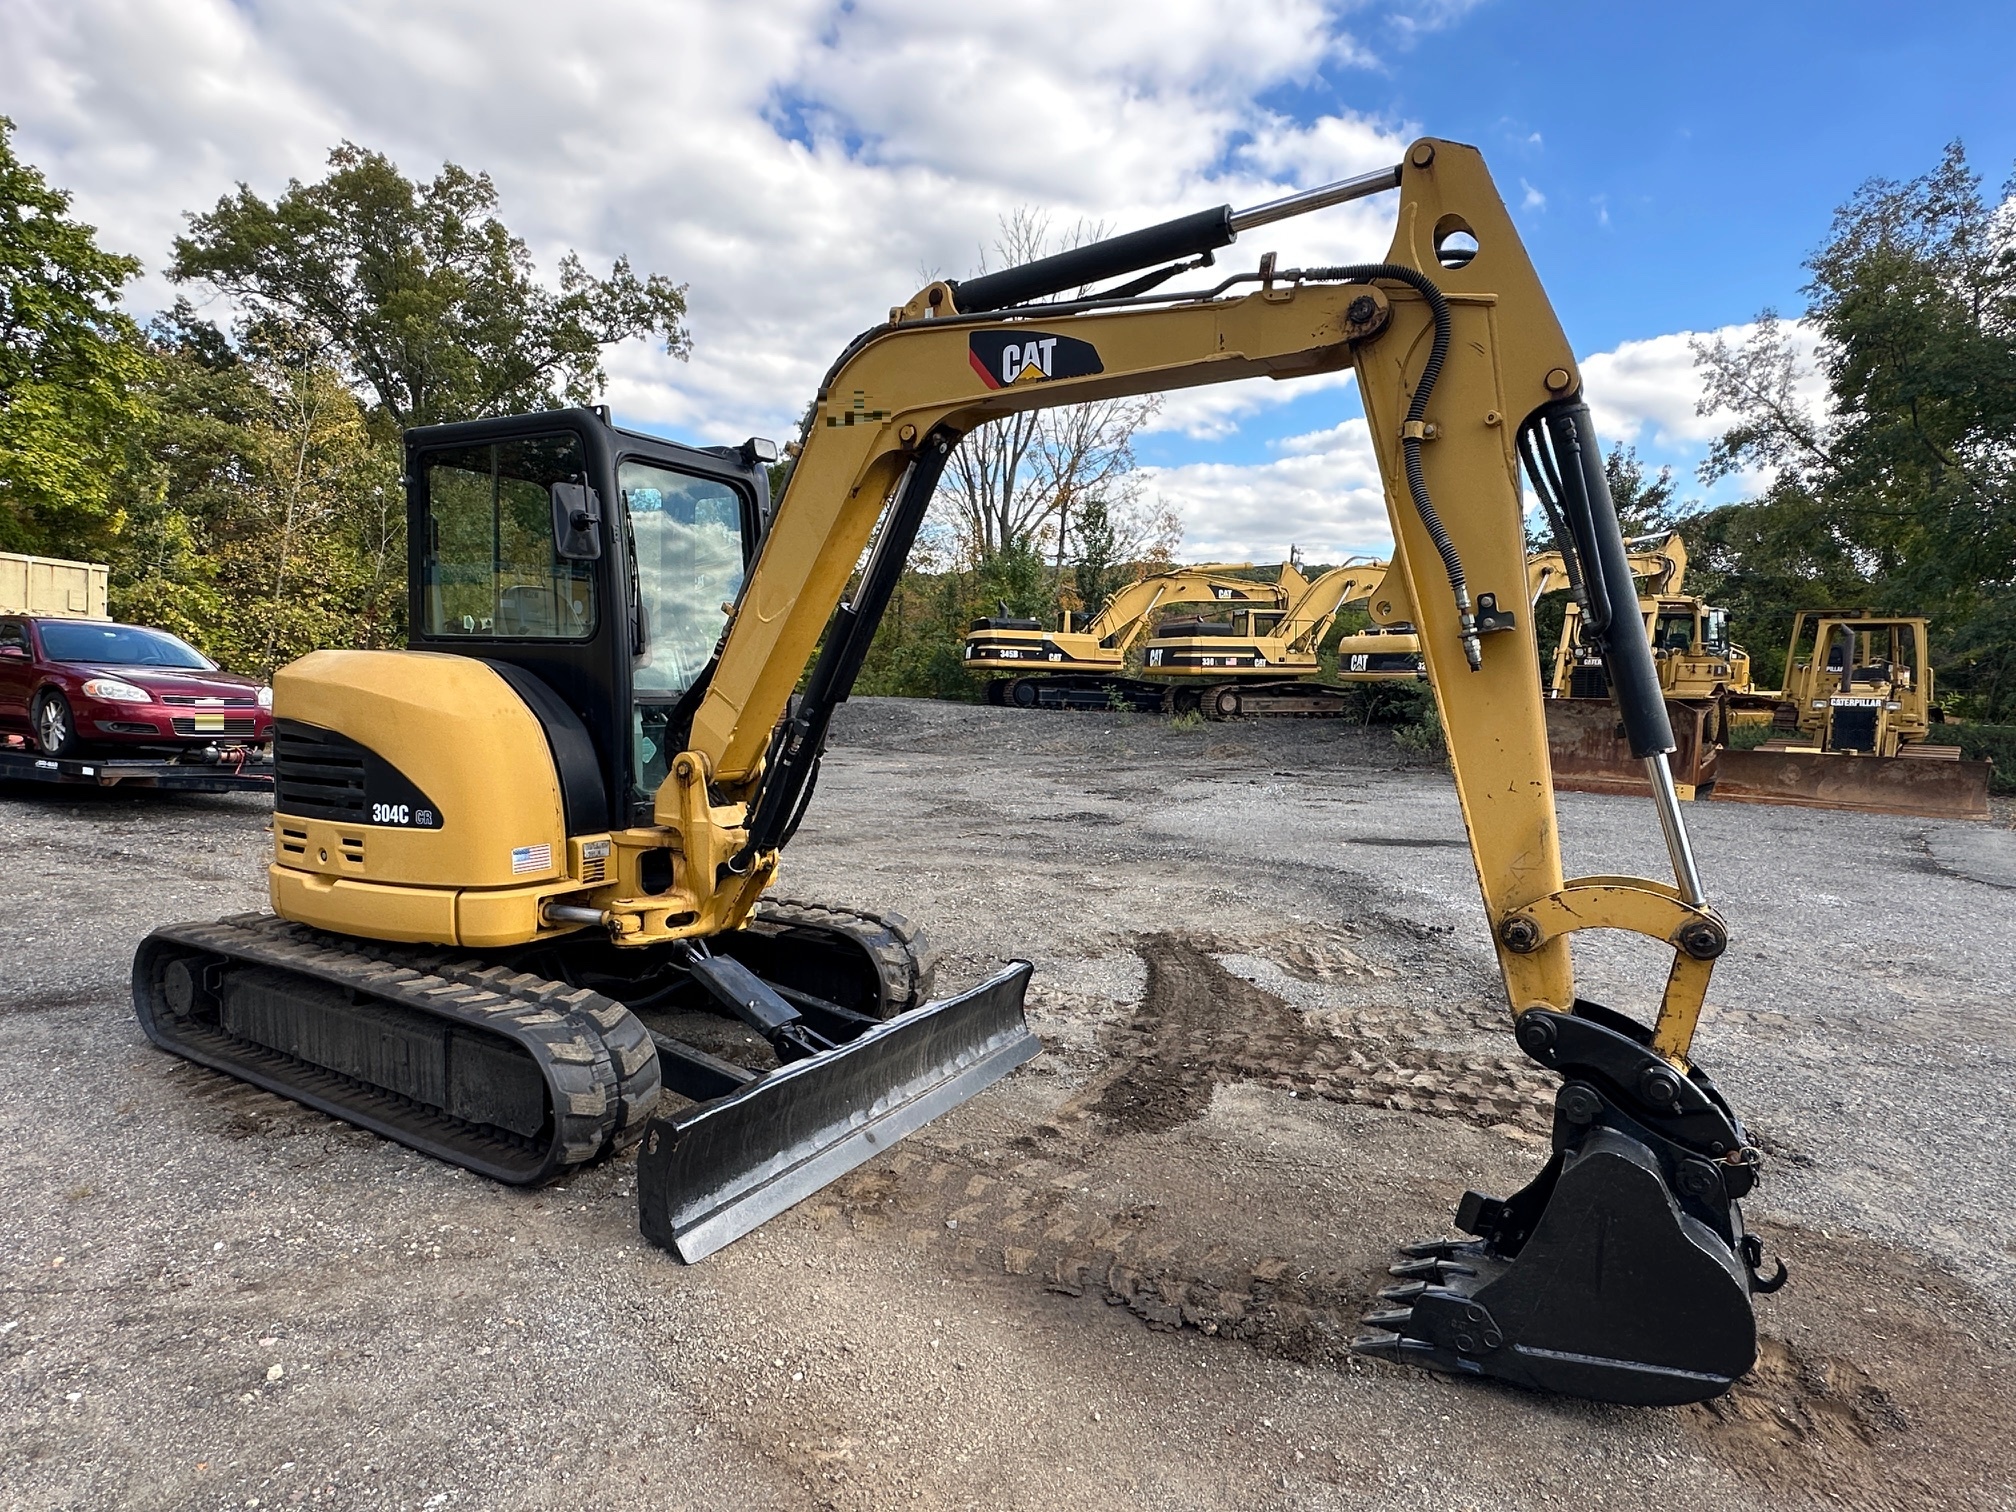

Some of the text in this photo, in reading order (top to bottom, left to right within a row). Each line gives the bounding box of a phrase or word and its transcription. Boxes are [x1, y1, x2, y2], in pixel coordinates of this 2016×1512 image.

[1002, 337, 1057, 383] CAT
[1218, 589, 1233, 599] CAT
[1000, 649, 1019, 659] 345B
[1048, 653, 1063, 662] CAT
[1149, 649, 1163, 667] CAT
[1254, 658, 1267, 668] CAT
[1350, 654, 1369, 672] CAT
[1417, 661, 1426, 670] 32
[1583, 658, 1603, 666] CATER
[1830, 698, 1882, 707] CATERPILLAR
[372, 803, 433, 826] 304C CR
